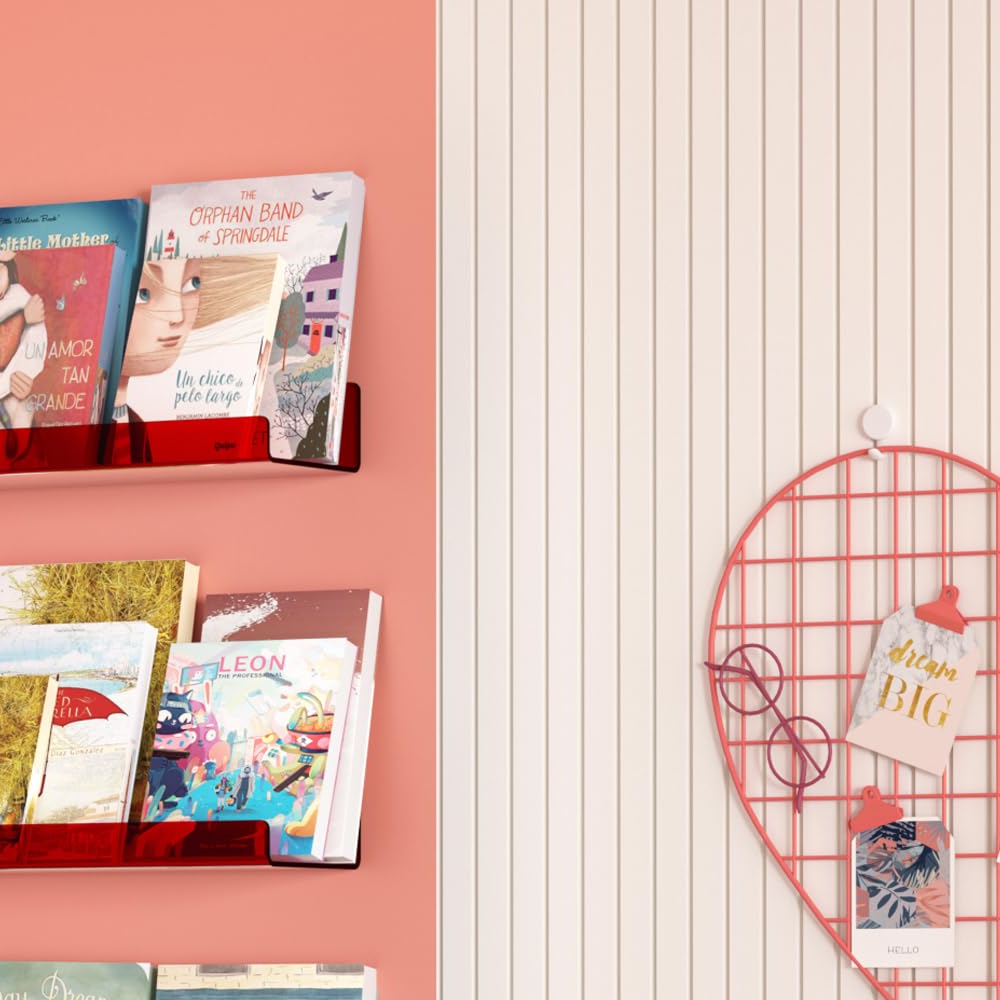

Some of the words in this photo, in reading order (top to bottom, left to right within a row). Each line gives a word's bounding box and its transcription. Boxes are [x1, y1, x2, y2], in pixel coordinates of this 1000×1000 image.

[240, 190, 257, 200] THE
[189, 205, 254, 226] ORPHAN
[259, 202, 304, 223] BAND
[46, 232, 109, 248] Mother
[198, 230, 210, 243] of
[212, 224, 291, 246] SPRINGDALE
[24, 342, 46, 360] UN
[47, 339, 94, 359] AMOR
[62, 364, 91, 384] TAN
[176, 369, 195, 389] Un
[199, 369, 235, 387] chico
[24, 392, 87, 412] GRANDE
[173, 387, 203, 410] pelo
[204, 388, 242, 409] largo
[218, 655, 286, 672] LEON
[888, 638, 957, 681] dream
[877, 671, 952, 728] BIG
[887, 945, 919, 954] HELLO
